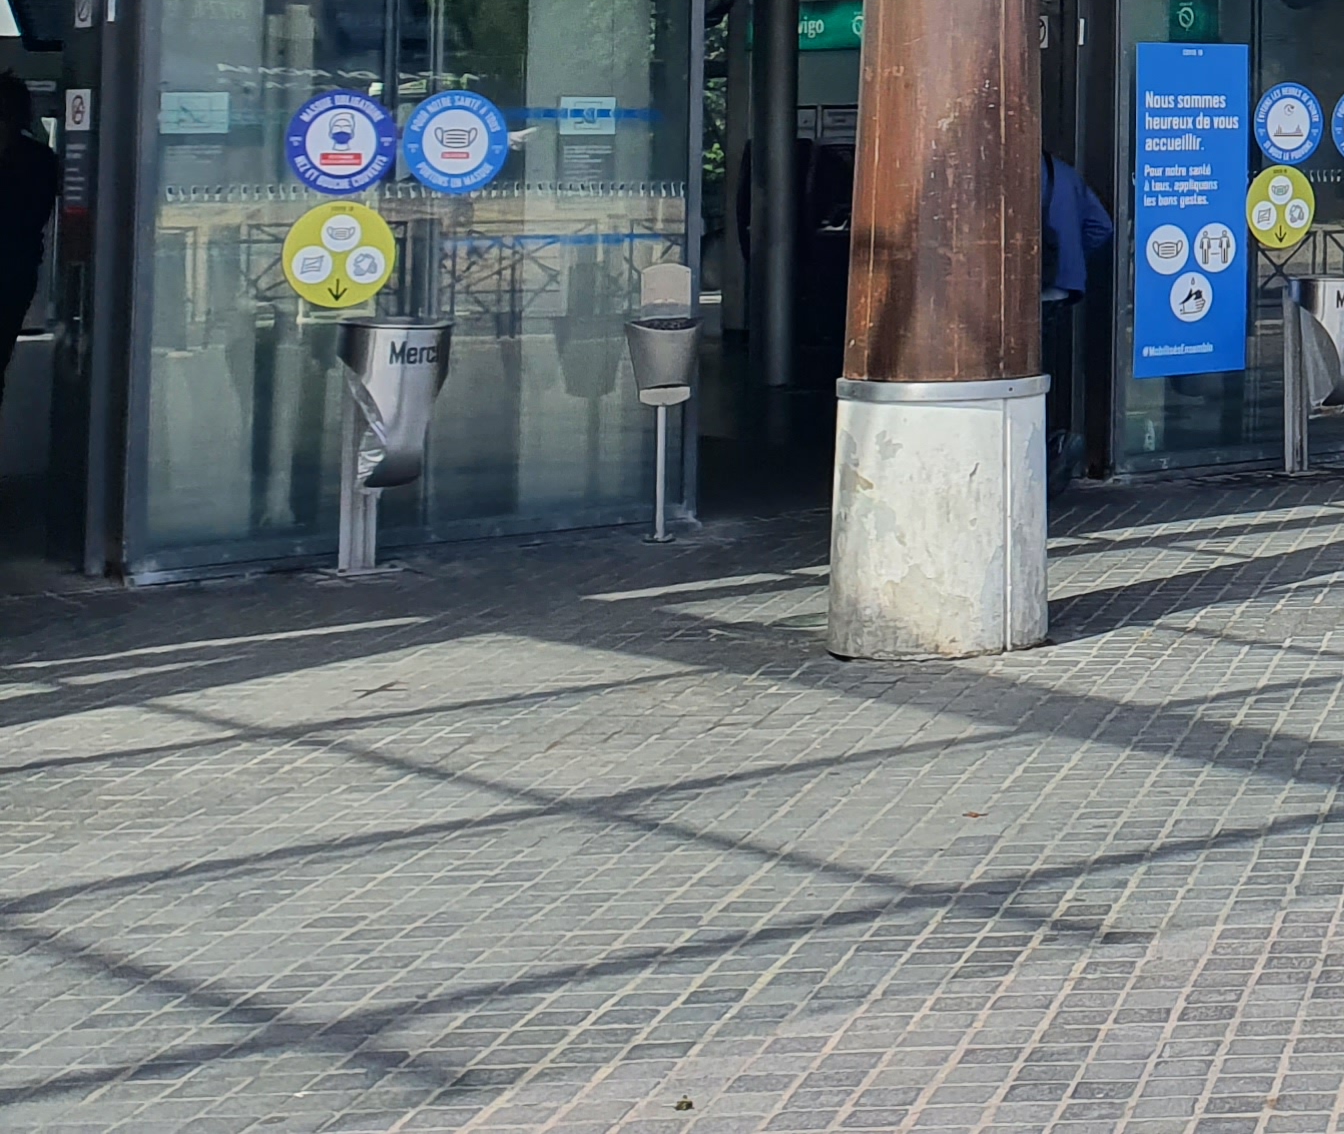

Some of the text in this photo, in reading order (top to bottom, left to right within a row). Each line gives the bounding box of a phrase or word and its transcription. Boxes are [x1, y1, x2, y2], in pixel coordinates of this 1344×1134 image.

[798, 16, 825, 38] vigo
[1145, 91, 1226, 109] Nous sommes
[1145, 112, 1239, 130] heureux de vous
[1144, 133, 1205, 151] accueillir.
[1144, 164, 1162, 177] Pour
